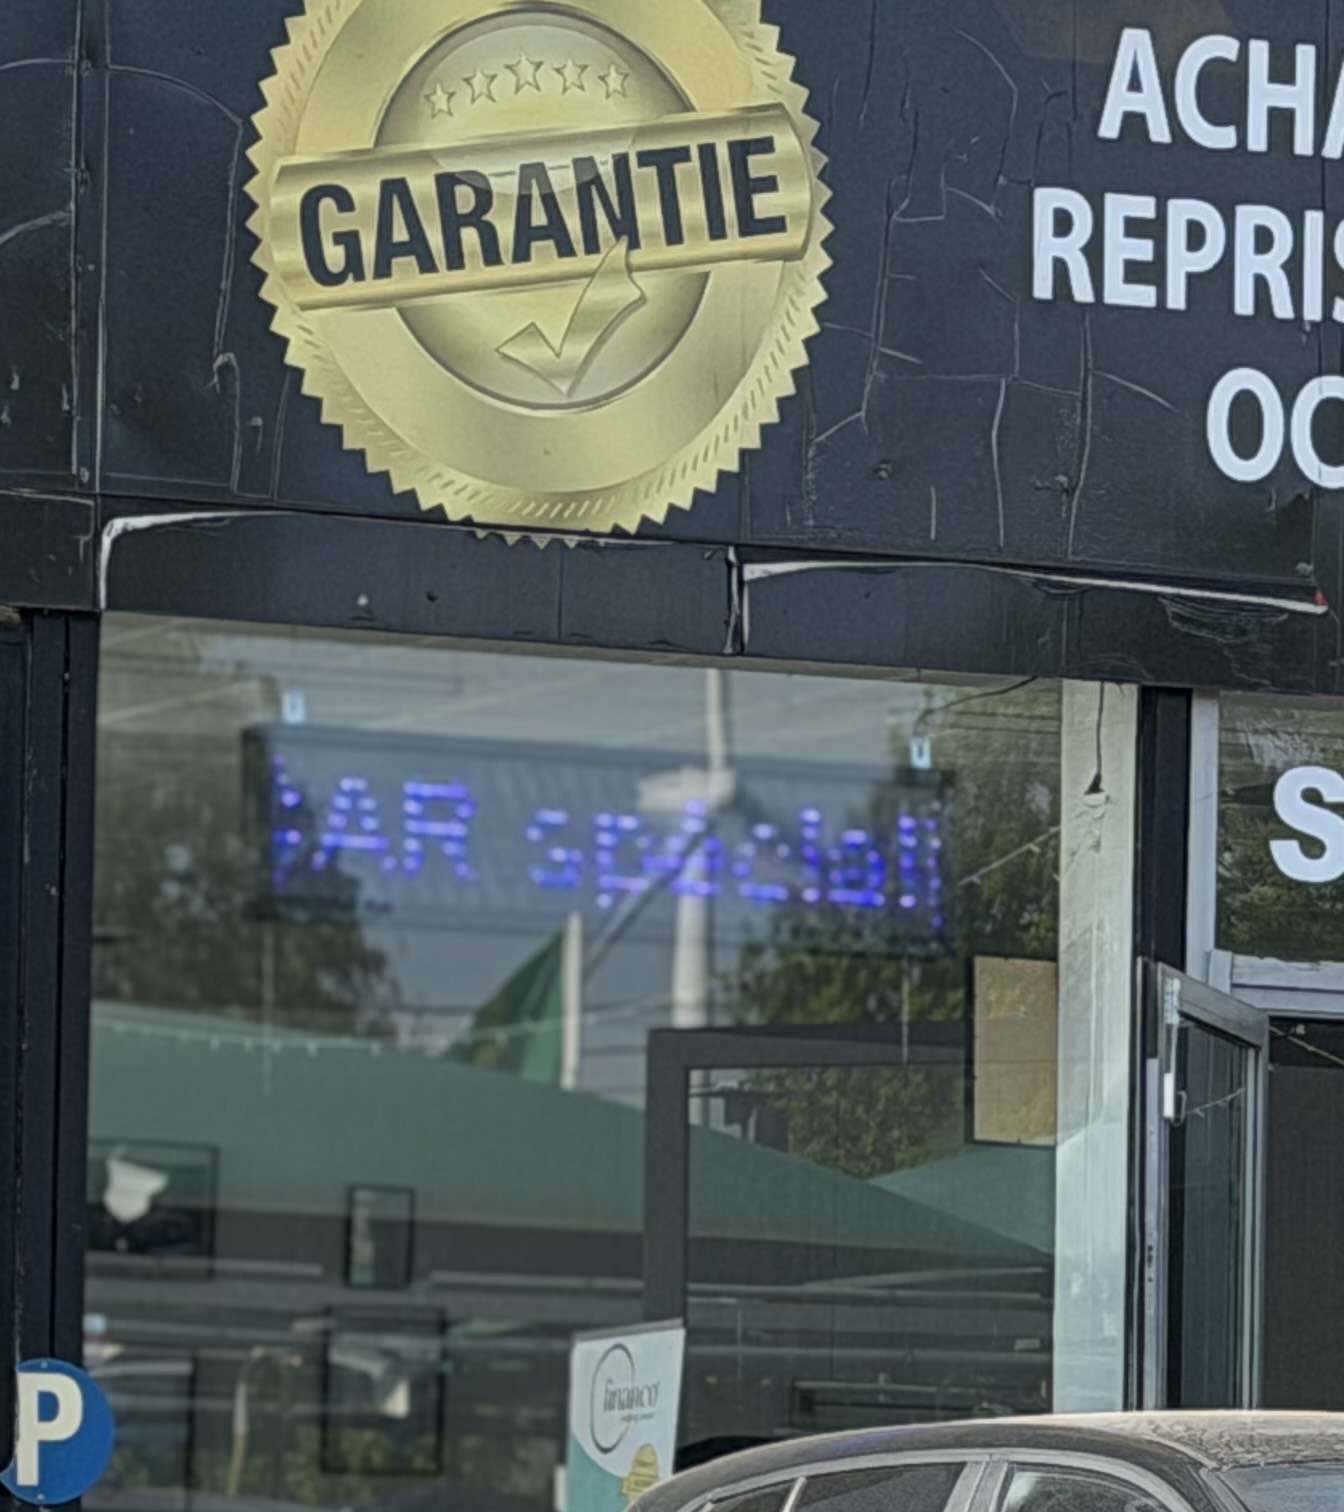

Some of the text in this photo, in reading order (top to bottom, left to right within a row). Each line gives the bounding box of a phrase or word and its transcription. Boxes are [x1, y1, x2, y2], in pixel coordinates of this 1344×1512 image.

[301, 136, 787, 288] GARANTIE
[1032, 187, 1344, 323] REPRI
[15, 1371, 84, 1487] P
